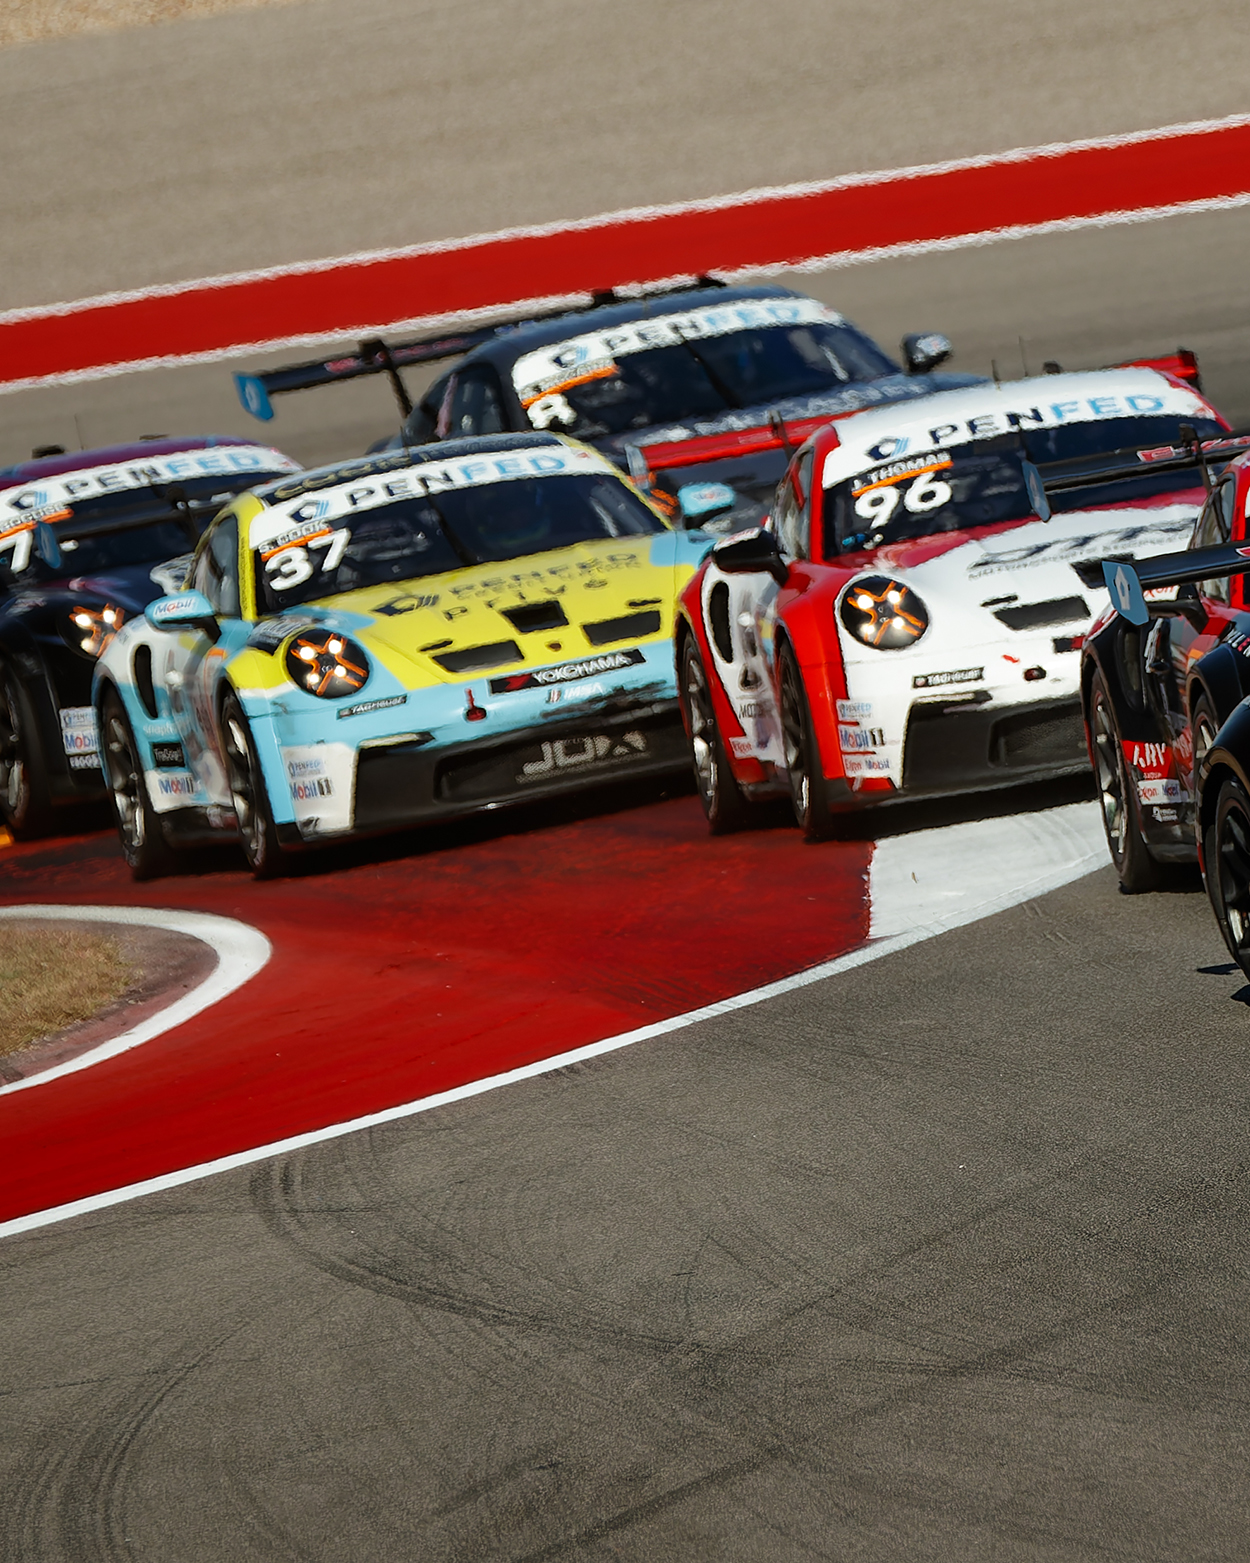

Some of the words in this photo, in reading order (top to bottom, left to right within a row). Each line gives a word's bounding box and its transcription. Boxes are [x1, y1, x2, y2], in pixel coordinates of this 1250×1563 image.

[601, 305, 800, 352] PENFED
[927, 393, 1165, 445] PENFED
[61, 452, 261, 495] PENFED
[344, 453, 567, 506] PENFED
[854, 472, 952, 530] 96
[264, 527, 351, 592] 37
[153, 598, 194, 617] Mobil
[533, 653, 631, 685] YOKOHAMA
[839, 730, 870, 749] Mobil
[290, 779, 318, 800] Mobil
